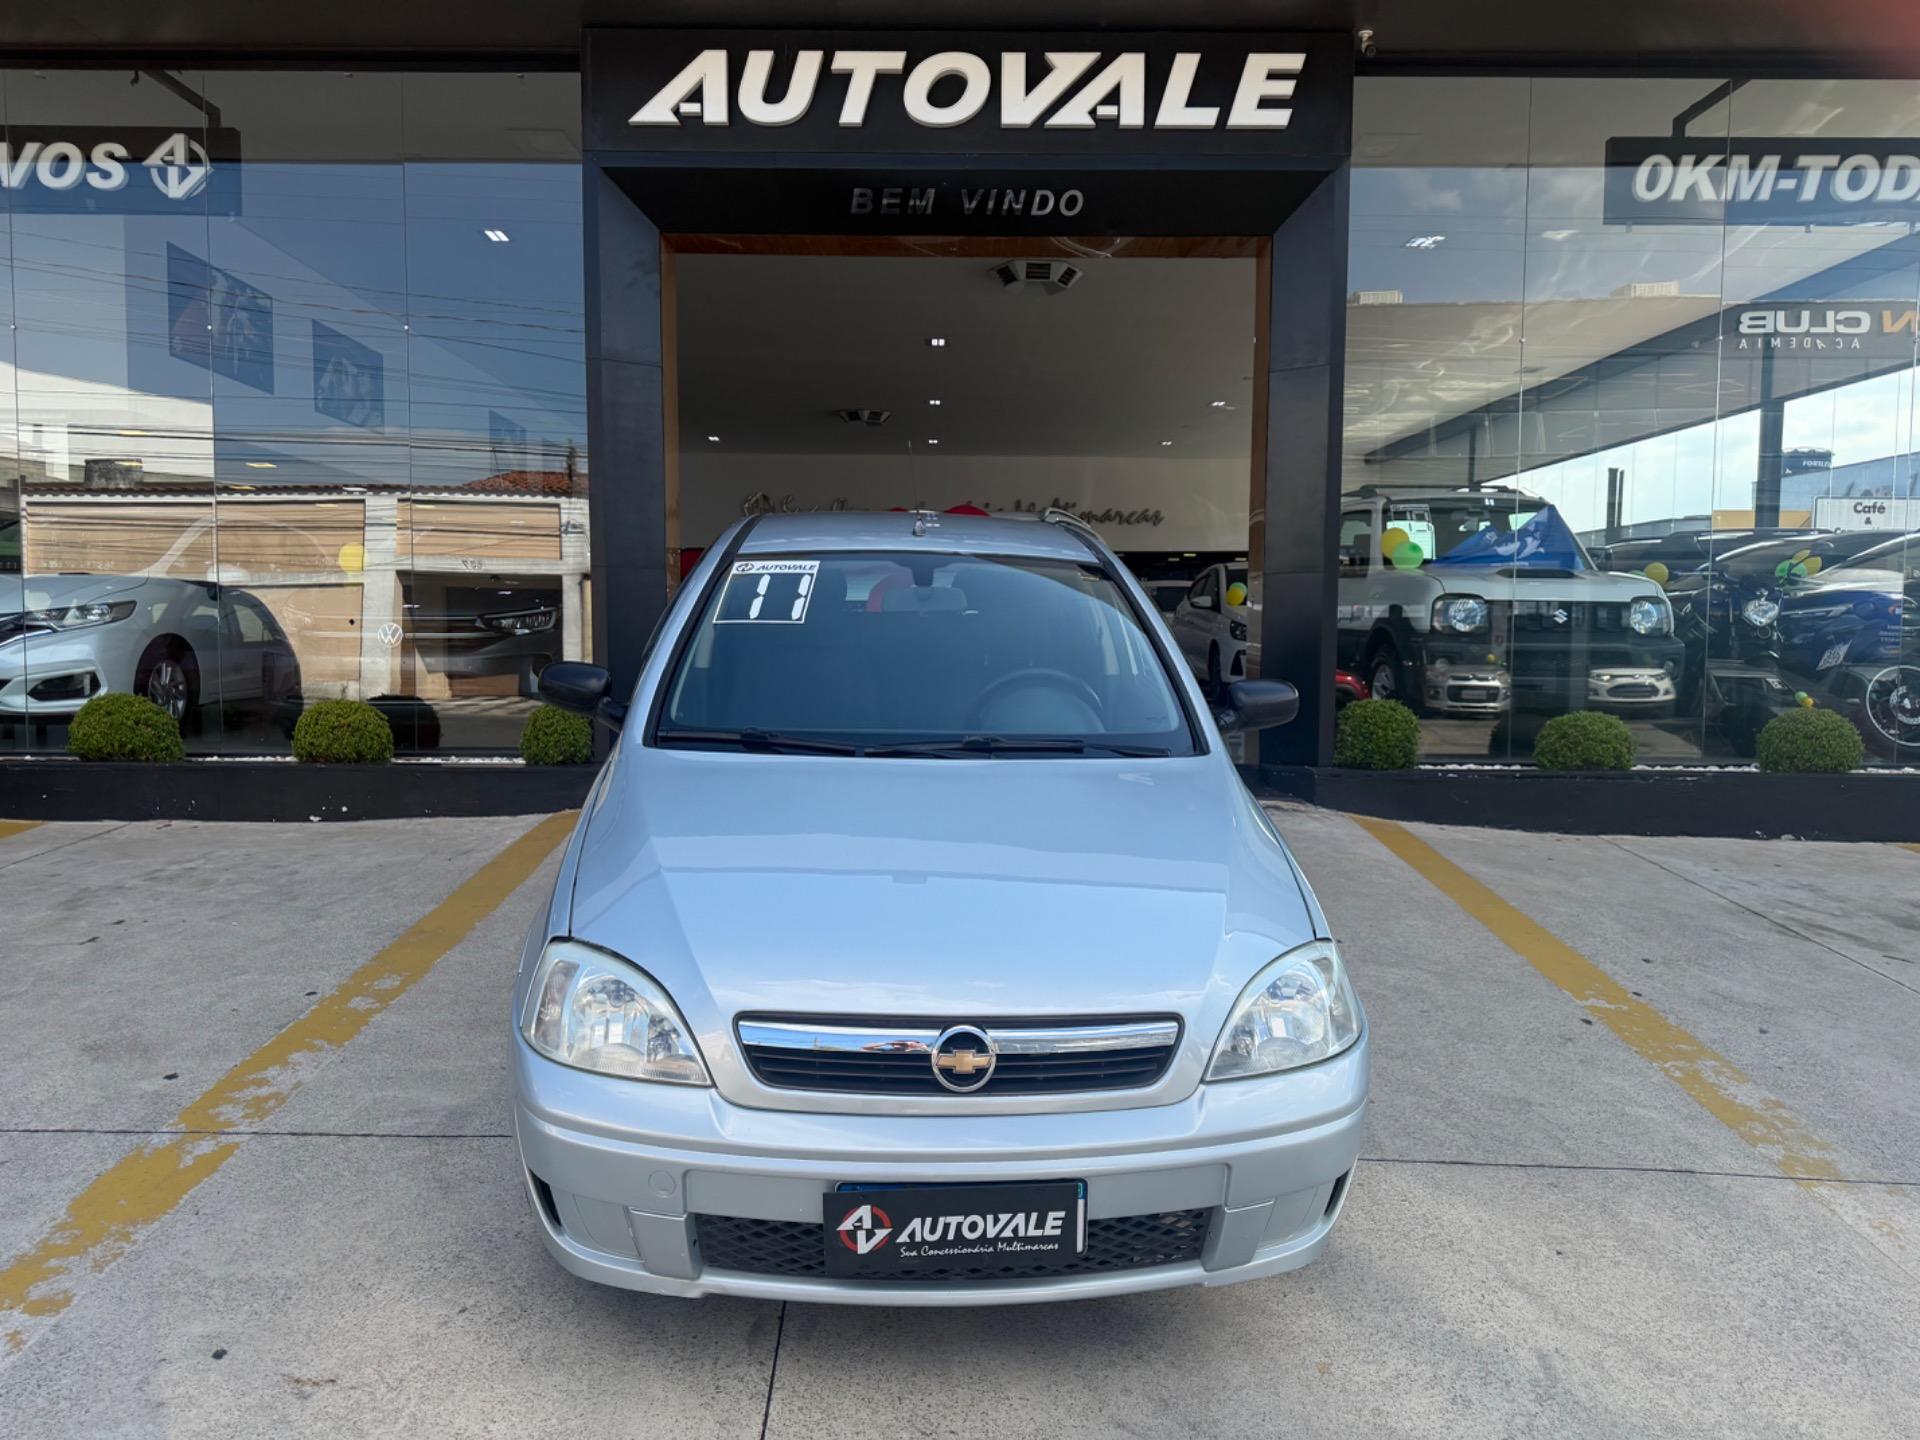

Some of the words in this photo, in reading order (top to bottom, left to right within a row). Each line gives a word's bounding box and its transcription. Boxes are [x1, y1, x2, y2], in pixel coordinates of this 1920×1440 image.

[628, 49, 1307, 130] AUTOVALE
[850, 187, 936, 215] BEM
[960, 188, 1084, 216] VINDO
[1853, 501, 1886, 514] Café
[896, 1211, 1067, 1244] AUTOVALE
[900, 1246, 918, 1259] Sua
[997, 1239, 1060, 1254] Multimarcas
